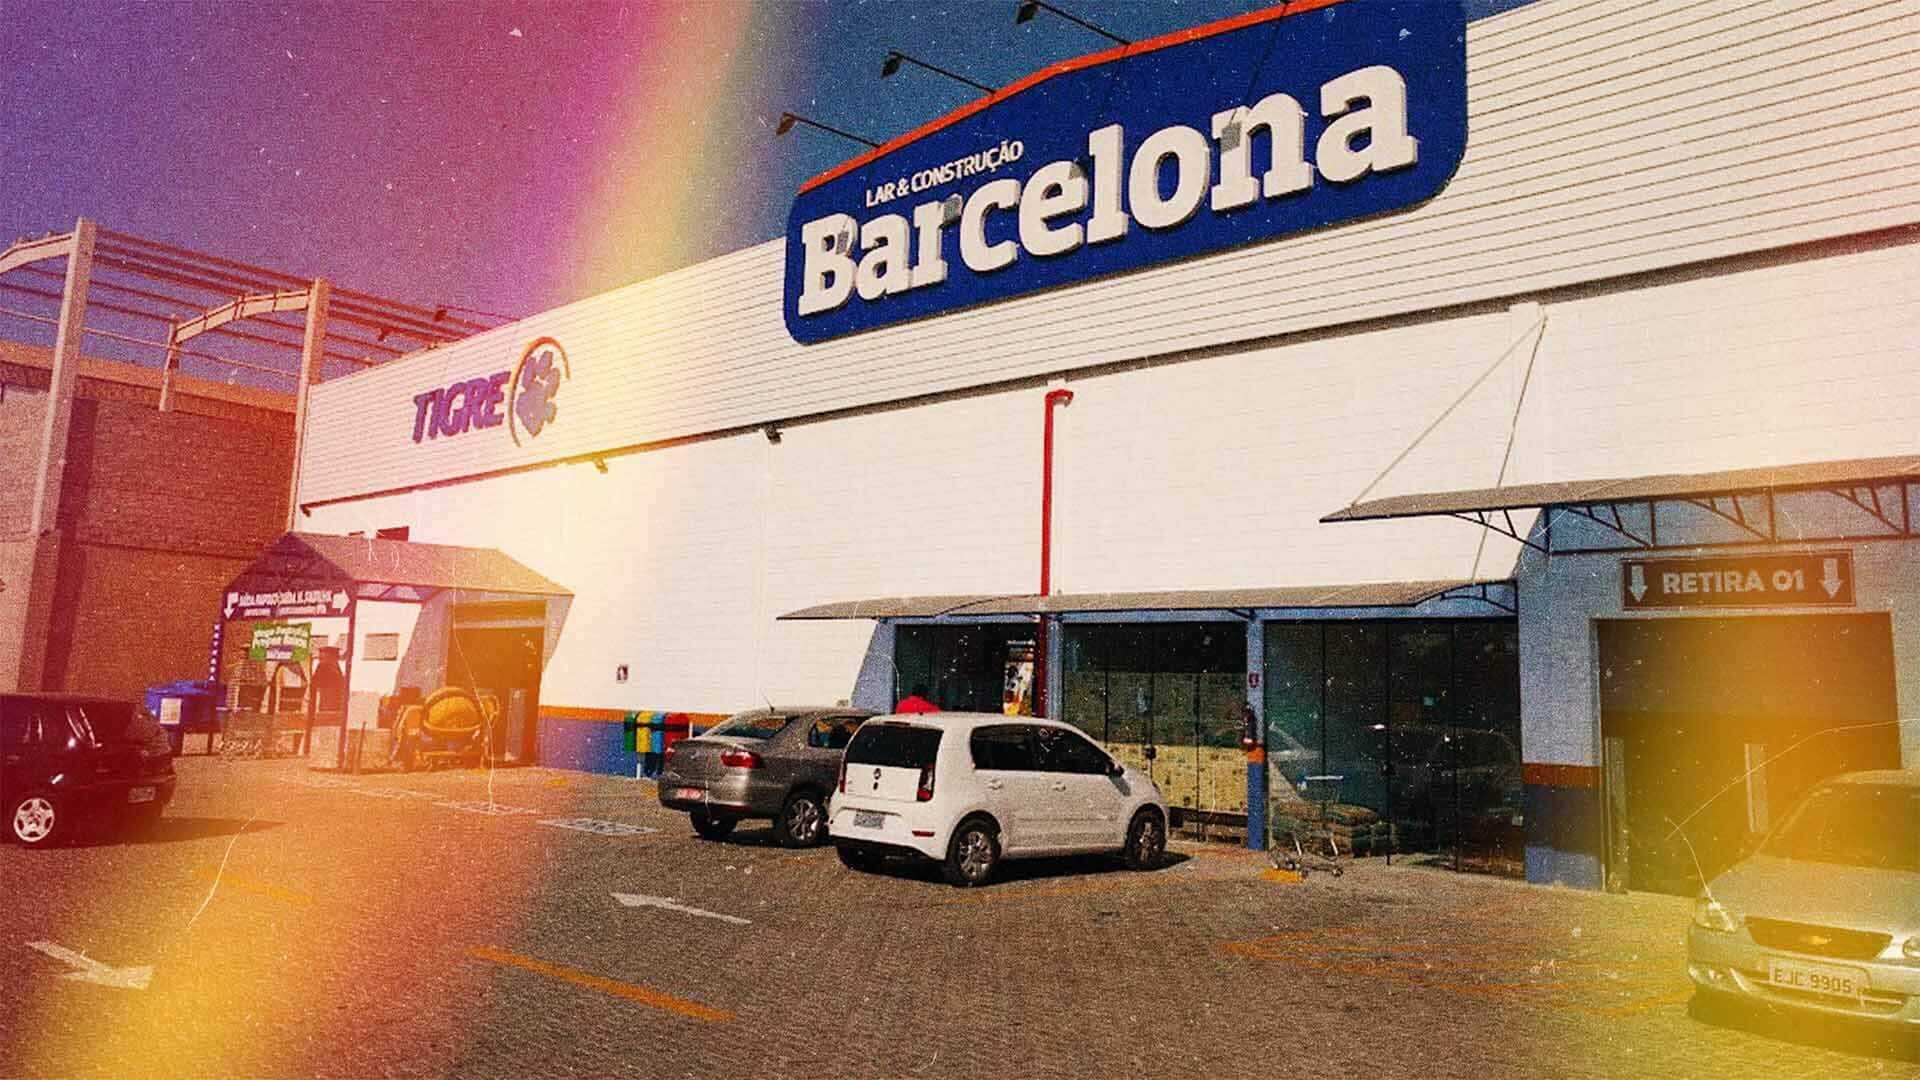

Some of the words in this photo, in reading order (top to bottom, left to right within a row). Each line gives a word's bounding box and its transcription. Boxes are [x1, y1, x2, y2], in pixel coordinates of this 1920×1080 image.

[799, 65, 1418, 316] Barcelona
[866, 183, 896, 207] LAR
[896, 178, 909, 197] &
[911, 140, 1024, 193] CONSTRUÇÃO
[413, 371, 511, 443] TIGRE
[1663, 571, 1765, 593] RETIRA
[1772, 569, 1804, 591] 01
